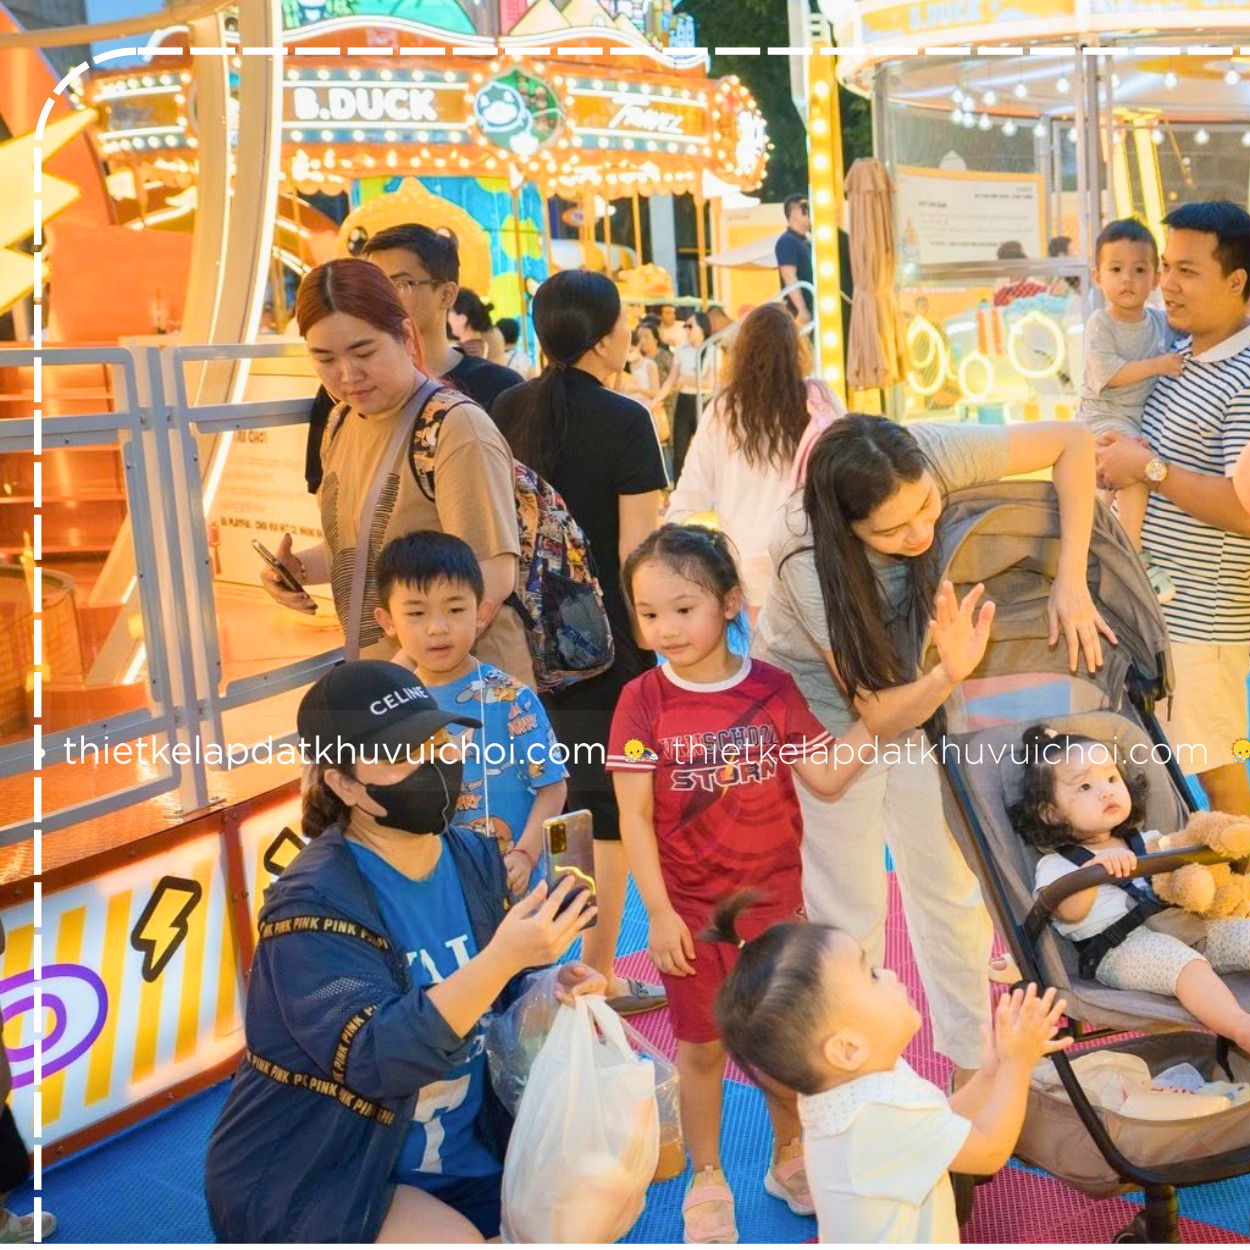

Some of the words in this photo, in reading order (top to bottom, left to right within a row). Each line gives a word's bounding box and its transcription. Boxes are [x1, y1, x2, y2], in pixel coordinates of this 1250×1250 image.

[293, 87, 437, 121] B.DUCK
[370, 686, 429, 715] CELINE
[323, 918, 356, 935] PINK
[309, 1077, 338, 1097] PINK
